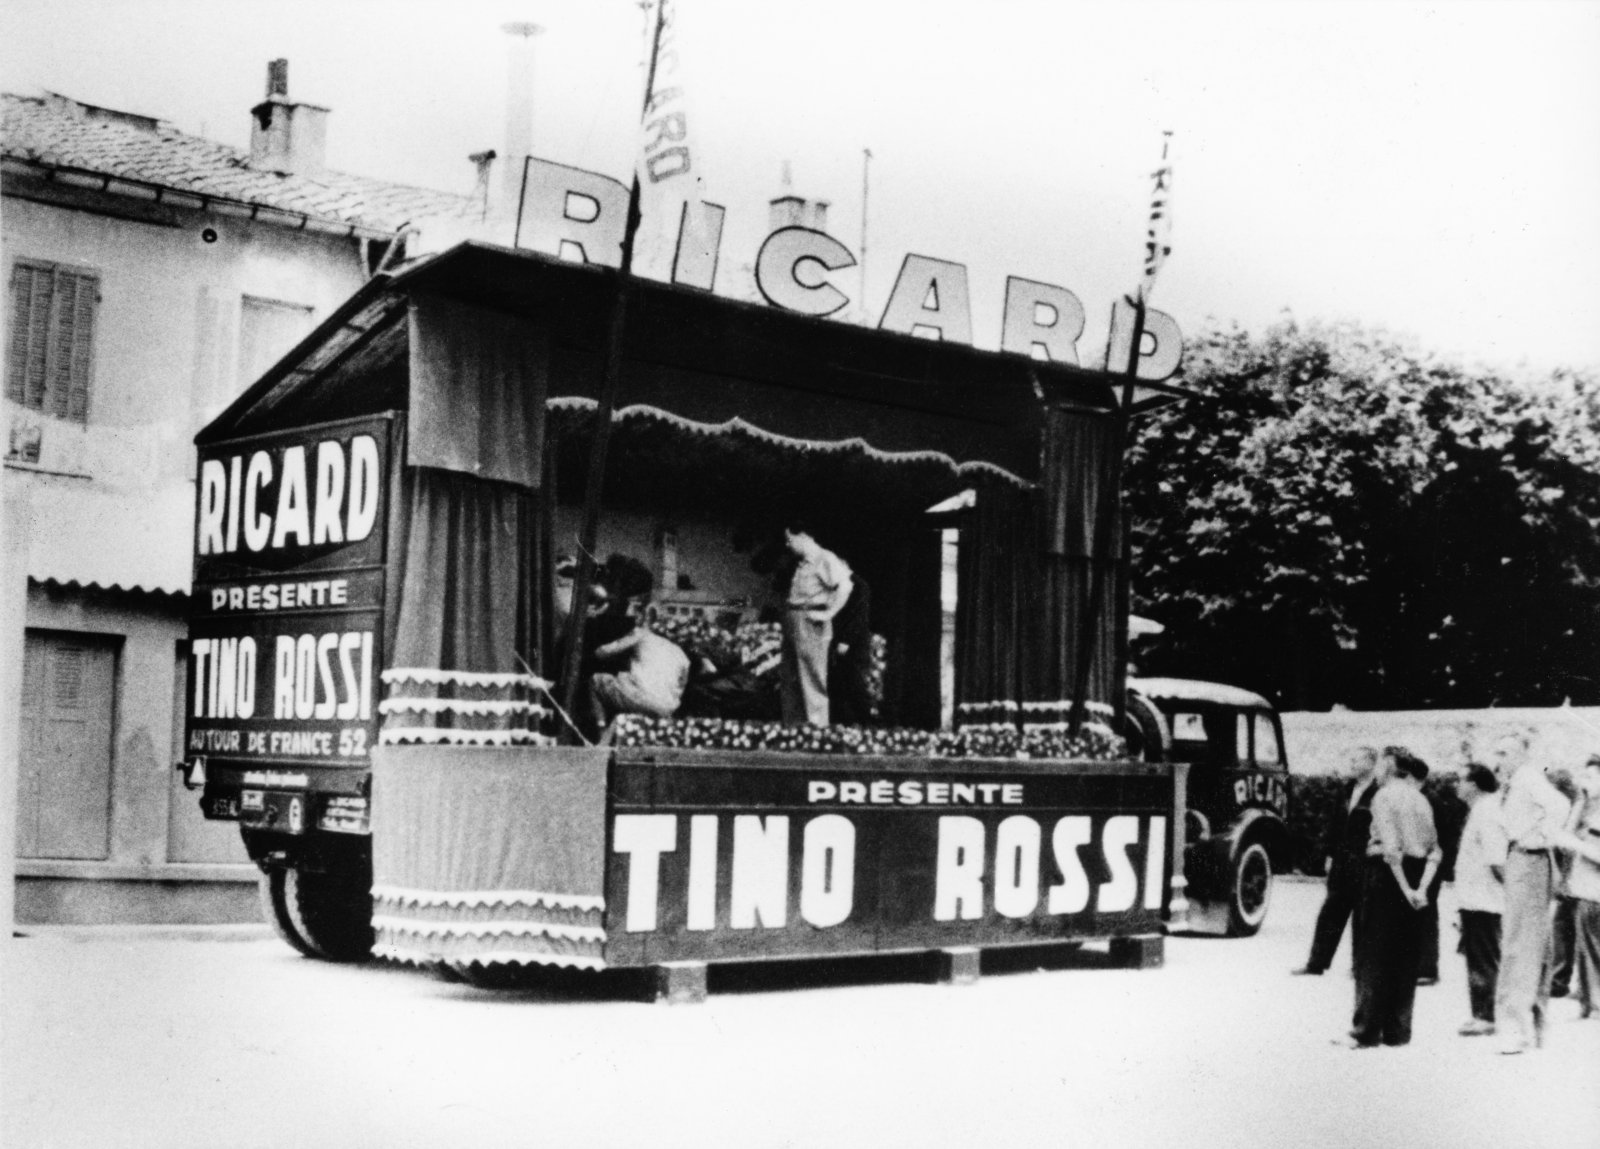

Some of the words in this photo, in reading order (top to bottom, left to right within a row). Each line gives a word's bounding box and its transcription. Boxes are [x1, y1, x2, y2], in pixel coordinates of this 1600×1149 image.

[515, 156, 1184, 383] RICARD
[199, 434, 380, 556] RICARD
[192, 635, 257, 720] TINO
[273, 631, 374, 720] ROSSI
[247, 730, 267, 755] DE
[270, 730, 333, 756] FRANCE
[338, 727, 367, 757] 52
[807, 779, 1024, 805] PRÉSENTE
[613, 814, 856, 932] TINO
[934, 815, 1167, 921] ROSSI
